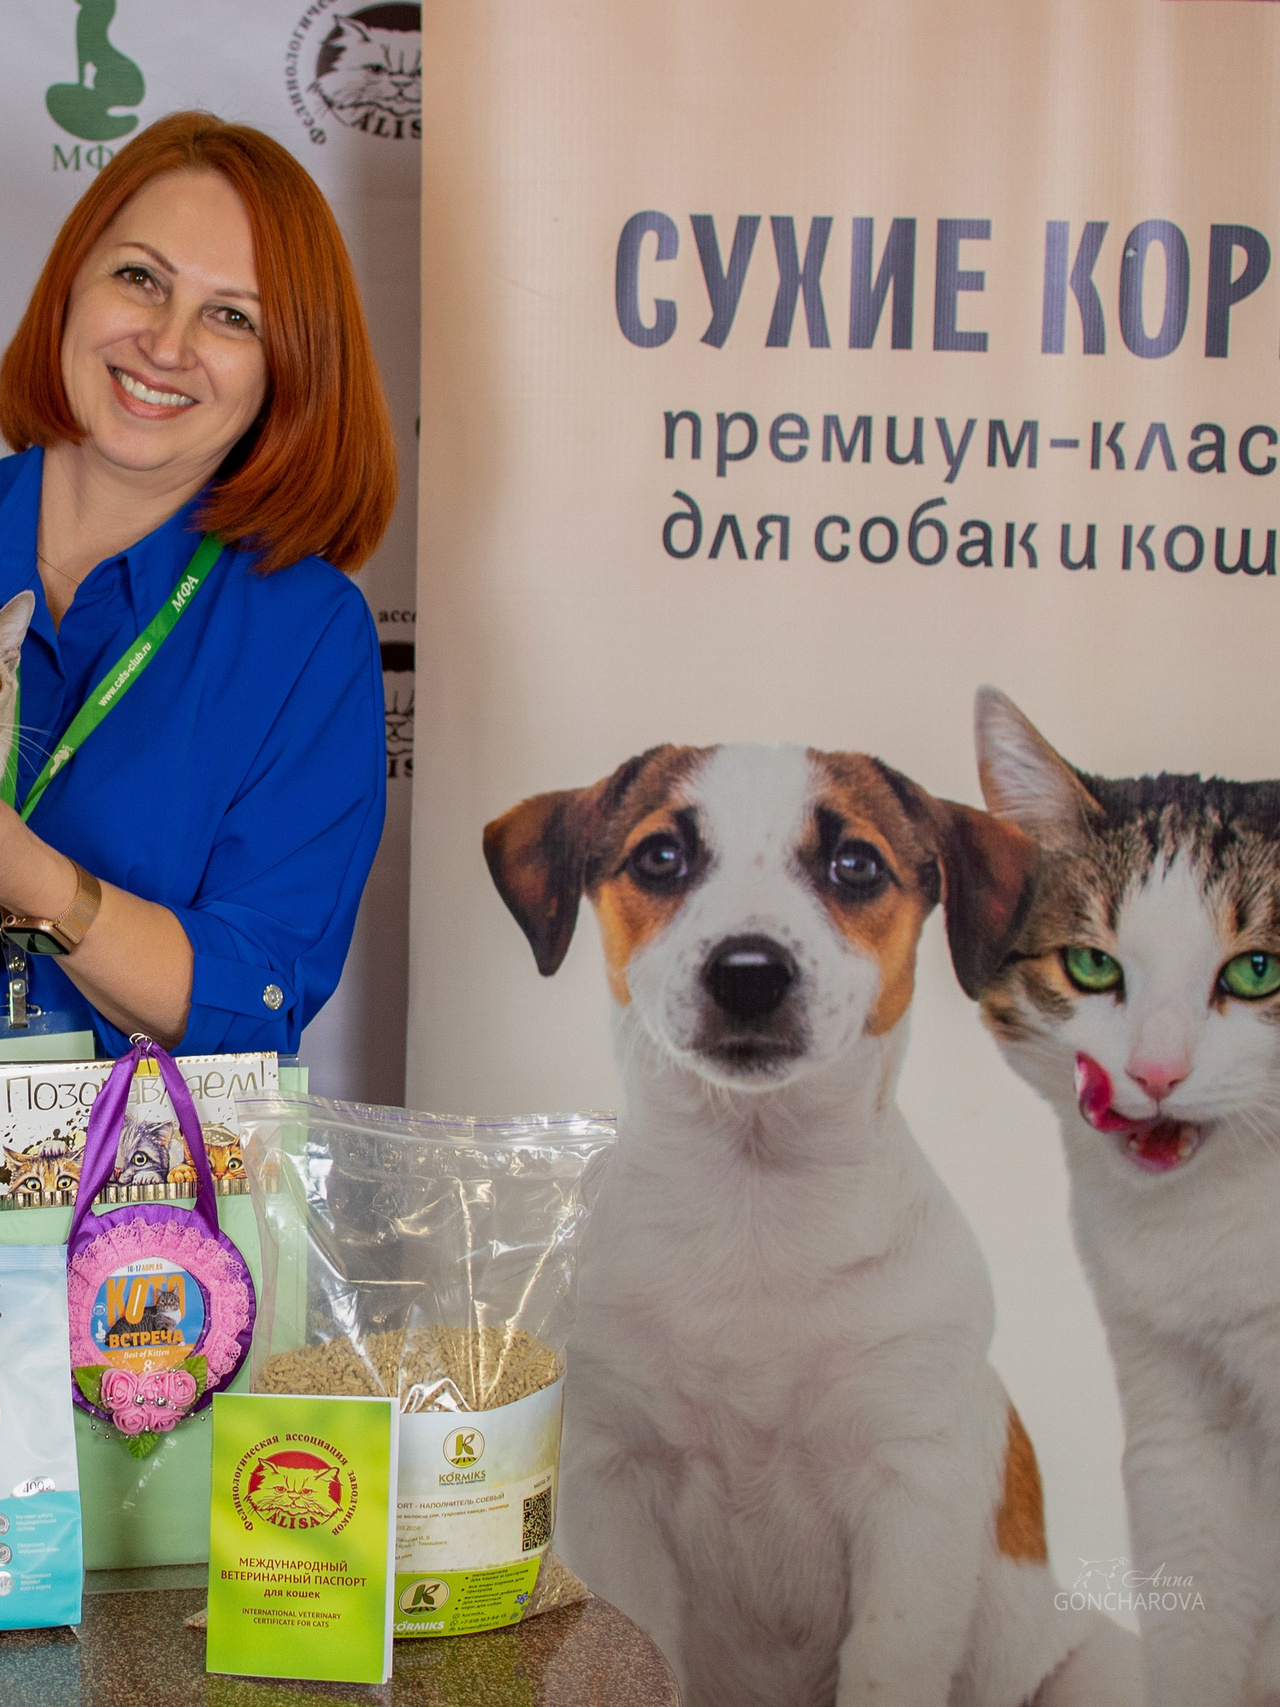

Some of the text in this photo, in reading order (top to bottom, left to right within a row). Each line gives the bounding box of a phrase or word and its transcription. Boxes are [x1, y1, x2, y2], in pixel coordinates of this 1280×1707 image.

[614, 210, 1280, 360] СУХИЕ КОР
[663, 409, 1280, 484] премиум-клас
[661, 490, 791, 563] для
[812, 496, 1039, 569] собак
[1059, 522, 1098, 570] и
[170, 574, 200, 614] МФА
[97, 641, 153, 708] www.cats-club.ru
[106, 1273, 186, 1328] КОТО
[109, 1328, 185, 1349] ВСТРЕЧА
[124, 1351, 139, 1359] Best
[140, 1350, 147, 1359] of
[232, 1433, 359, 1536] Фелинологическая ассоциация заводчиков
[420, 1492, 505, 1509] НАПОЛНИТЕЛЬ СОЕВЫЙ
[265, 1511, 321, 1530] ALISA
[239, 1557, 348, 1573] МЕЖДУНАРОДНЫЙ
[221, 1569, 367, 1587] ВЕТЕРИНАРНЫЙ ПАСПОРТ
[263, 1589, 321, 1599] для кошек
[242, 1607, 342, 1620] INTERNATIONAL VETERINARY
[253, 1618, 296, 1627] CERTIFICATE
[312, 1620, 330, 1628] CATS
